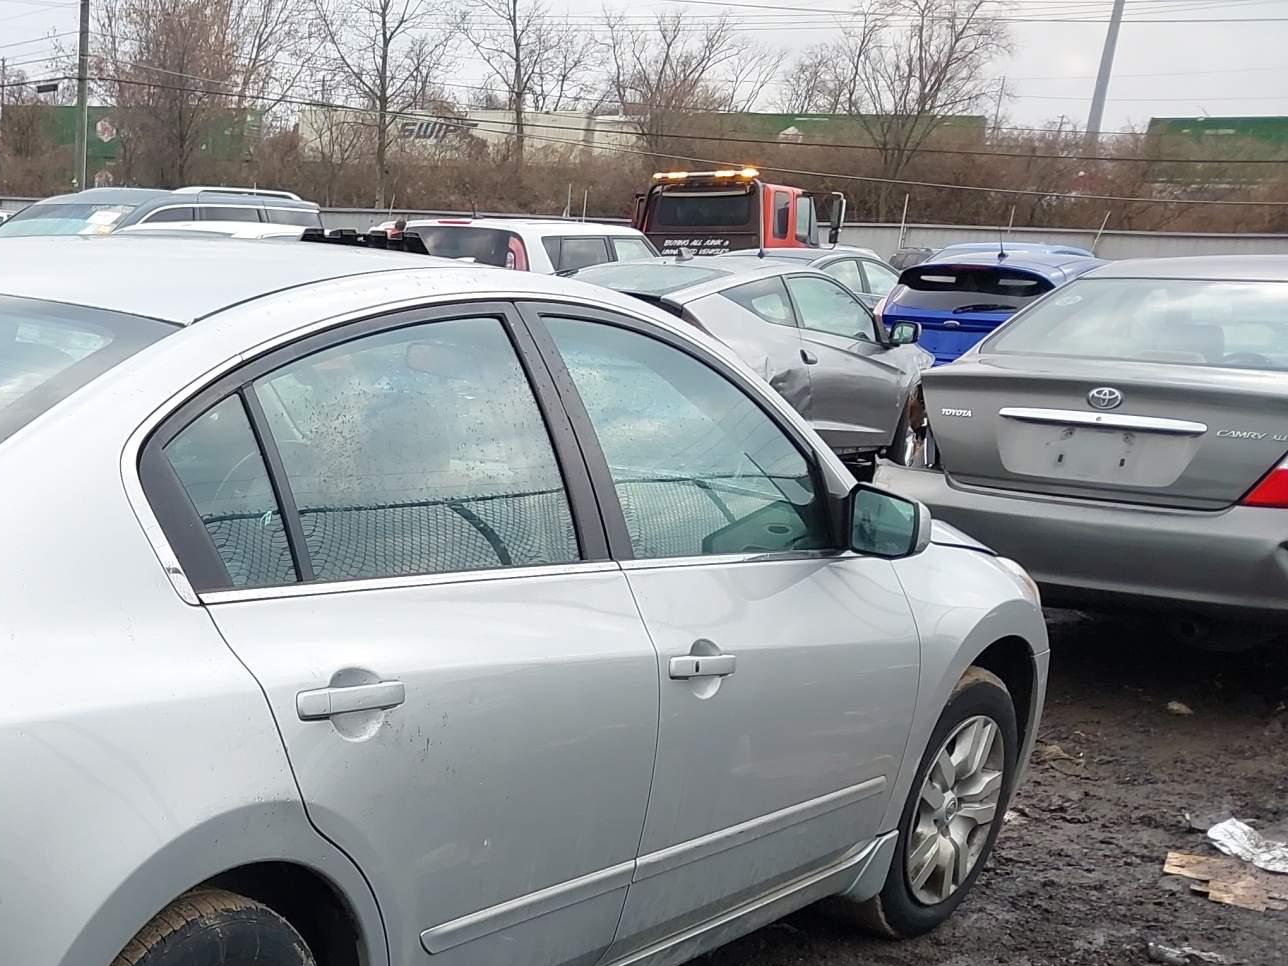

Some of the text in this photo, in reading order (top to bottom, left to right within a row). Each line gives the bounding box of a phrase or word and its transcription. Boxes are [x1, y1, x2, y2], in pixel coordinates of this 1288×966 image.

[663, 239, 690, 247] BUYING
[690, 239, 702, 247] ALL
[703, 239, 722, 247] JUNK
[941, 408, 972, 417] TOYOTA
[1216, 429, 1268, 440] CAMRY
